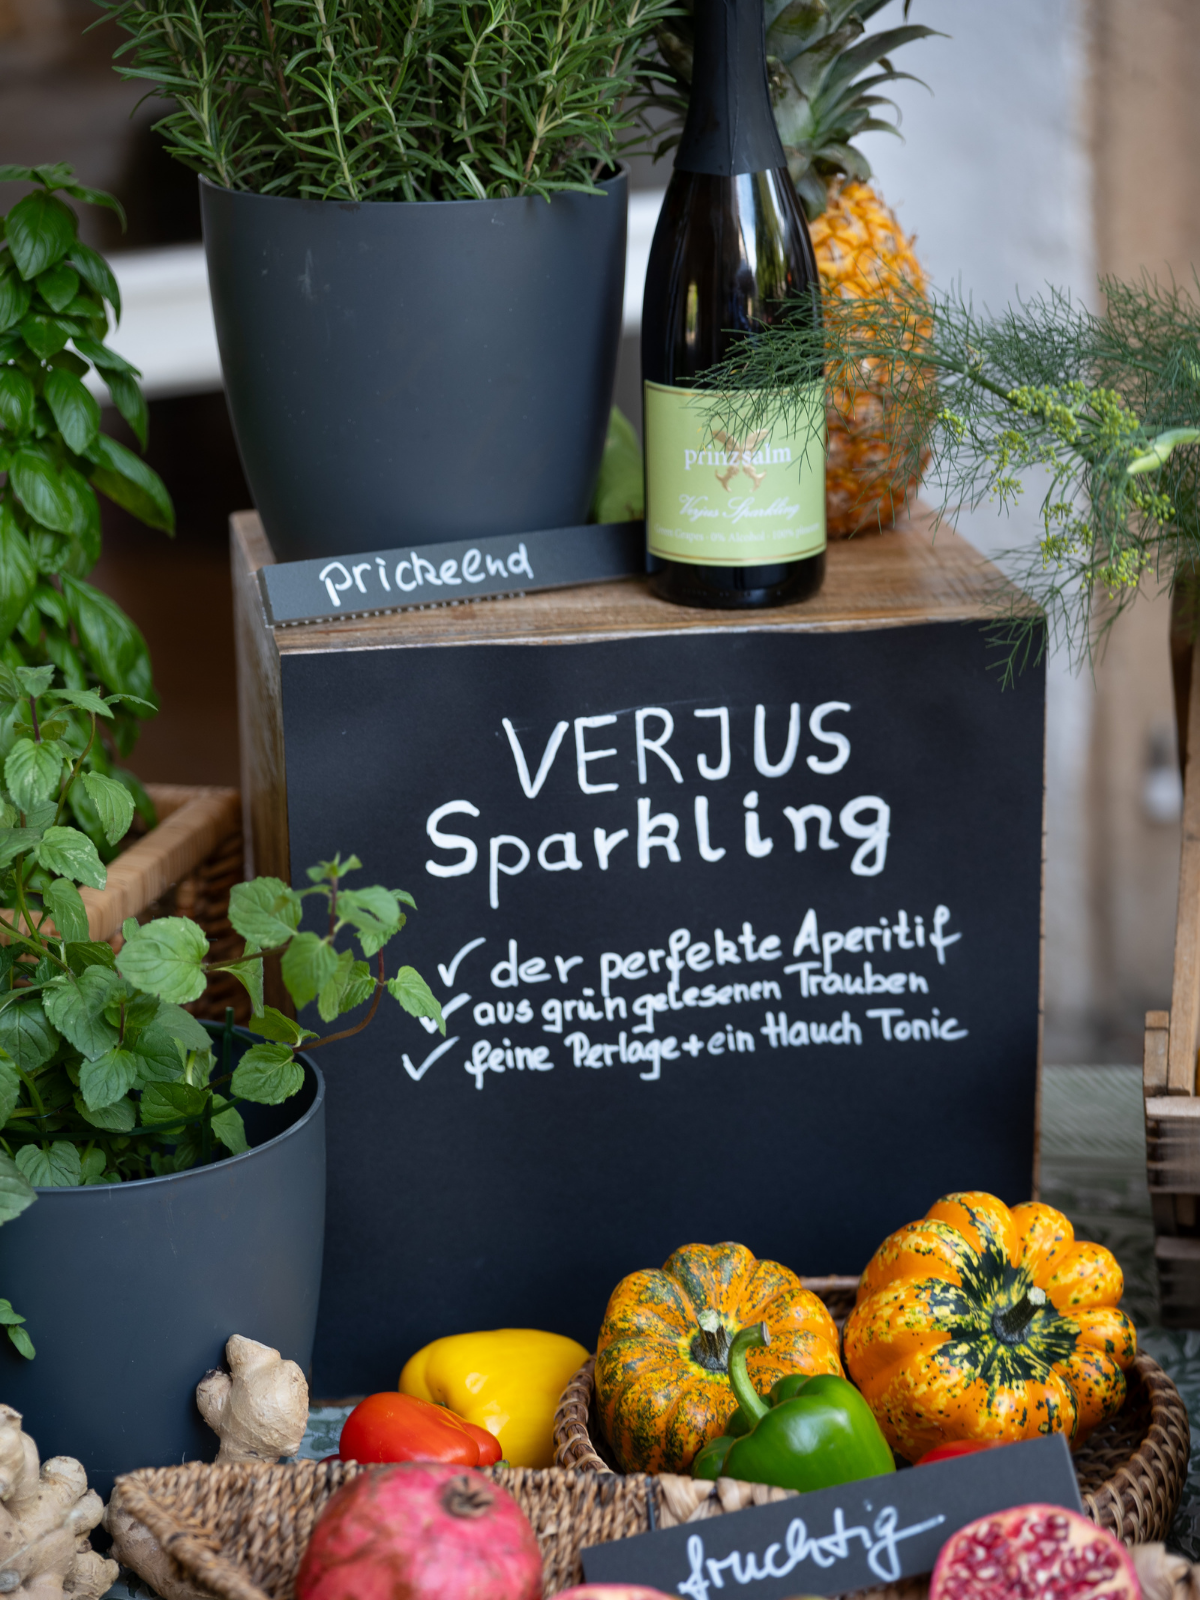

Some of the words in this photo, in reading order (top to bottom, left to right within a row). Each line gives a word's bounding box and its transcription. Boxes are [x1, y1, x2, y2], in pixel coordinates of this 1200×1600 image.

[722, 496, 800, 524] Sparkling
[319, 542, 534, 607] prickelnd
[501, 700, 852, 799] VERJUS
[425, 789, 891, 910] Sparkling
[472, 998, 534, 1027] aus
[783, 960, 929, 998] Trauben
[490, 938, 584, 988] der
[599, 921, 783, 999] perfekte
[793, 904, 962, 978] Aperitif
[463, 1037, 555, 1090] feine
[760, 1010, 863, 1048] Hauch
[865, 1007, 968, 1041] Tonic
[677, 1500, 946, 1600] fruchtig
